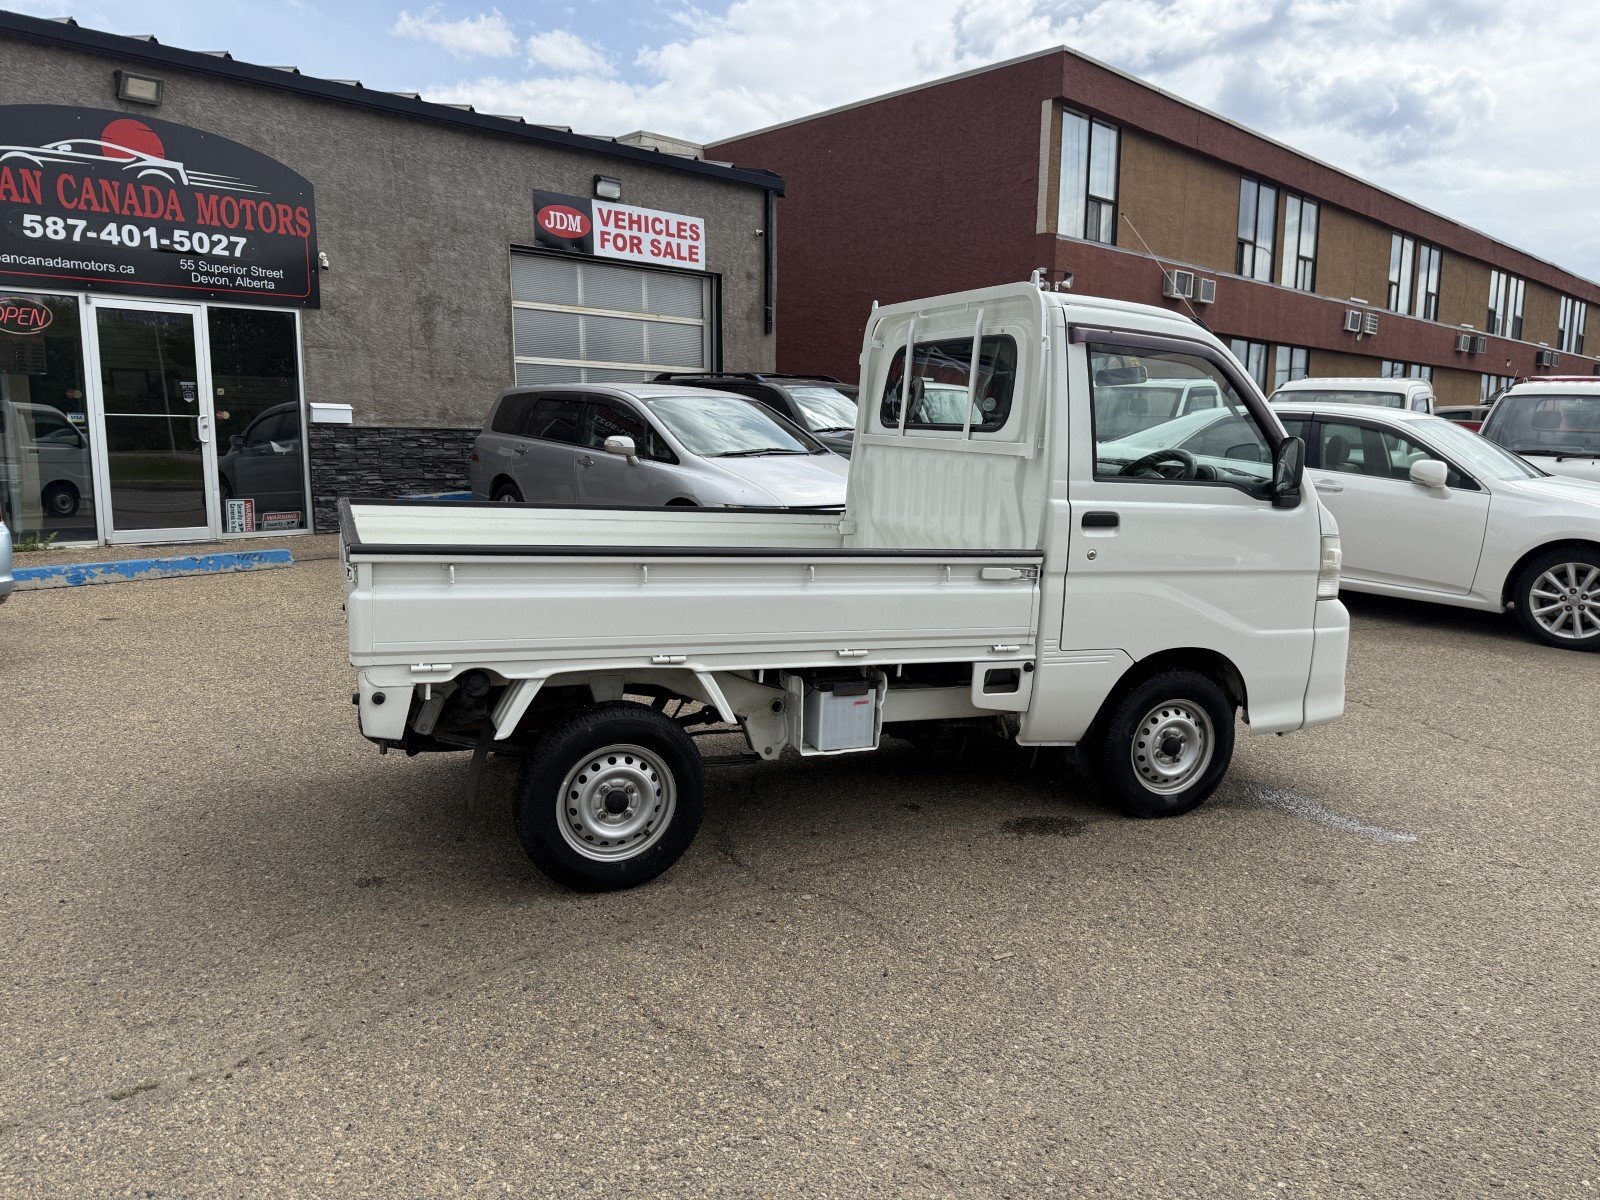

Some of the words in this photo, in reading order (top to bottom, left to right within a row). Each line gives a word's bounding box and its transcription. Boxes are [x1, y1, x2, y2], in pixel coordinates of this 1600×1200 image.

[56, 173, 185, 222] CANADA
[195, 192, 311, 238] MOTORS
[544, 210, 582, 233] JDM
[22, 213, 247, 258] 587-401-5027
[597, 207, 701, 242] VEHICLES
[600, 230, 643, 255] FOR
[650, 238, 700, 263] SALE
[179, 258, 195, 271] 55
[198, 260, 247, 278] Superior
[250, 265, 284, 279] Street
[191, 272, 233, 288] Devon,
[235, 276, 275, 290] Alberta
